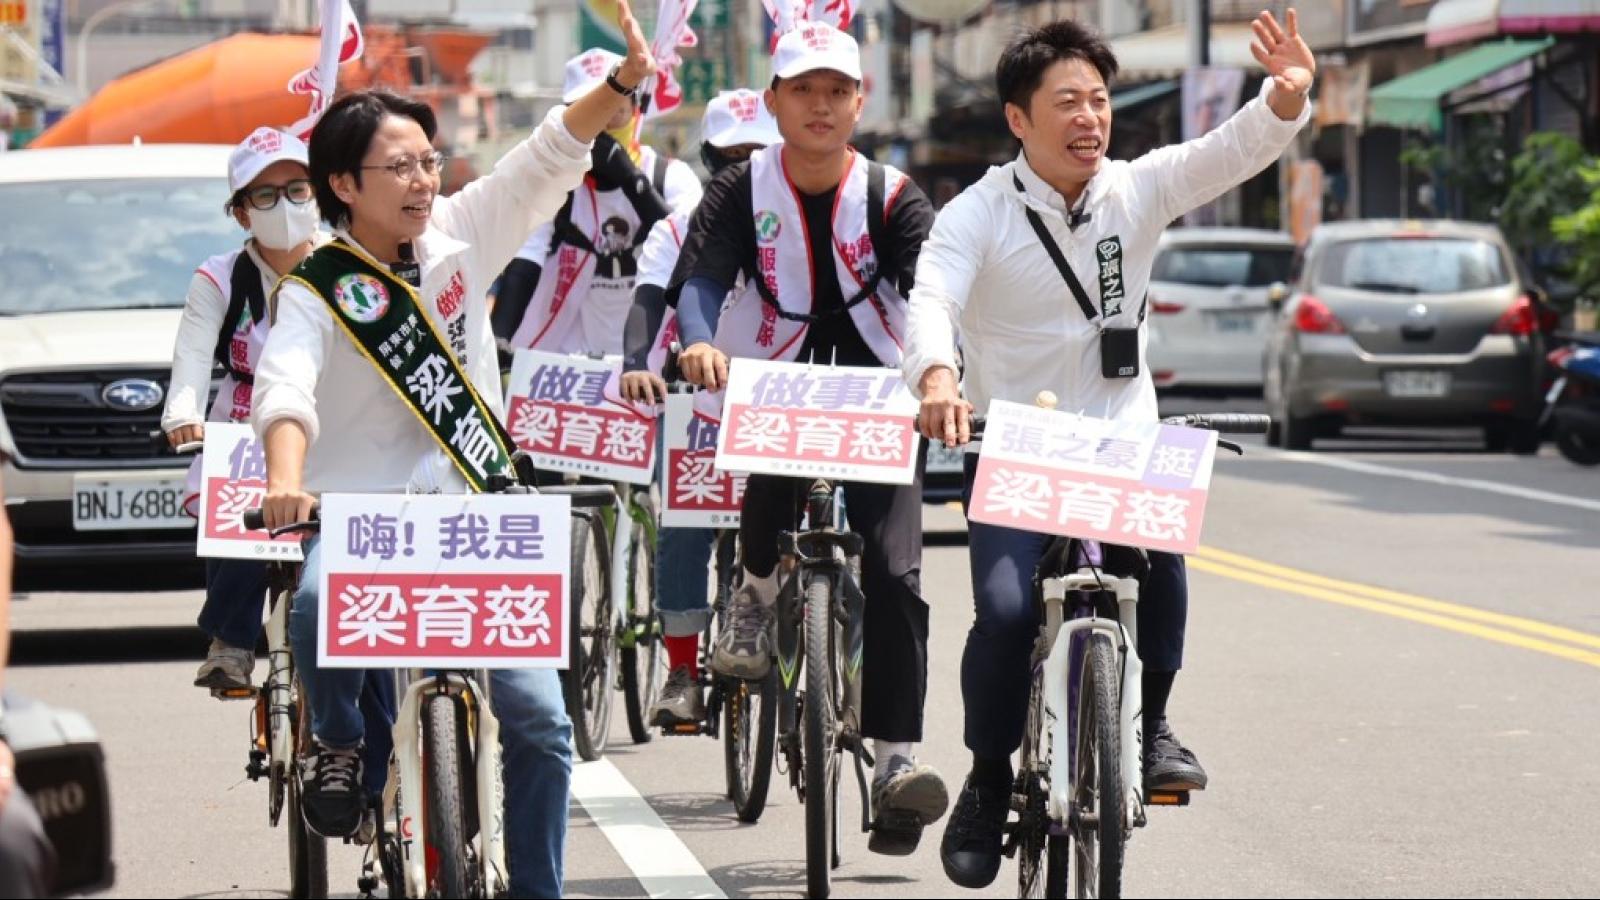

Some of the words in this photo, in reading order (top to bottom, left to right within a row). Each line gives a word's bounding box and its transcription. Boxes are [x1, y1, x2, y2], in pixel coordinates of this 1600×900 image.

[406, 353, 516, 480] 梁育
[751, 371, 902, 410] 做事!
[511, 402, 650, 463] 梁育慈
[733, 410, 906, 462] 梁育慈
[1001, 422, 1142, 471] 張之豪
[1152, 443, 1198, 479] 挺
[983, 467, 1191, 542] 梁育慈
[346, 512, 416, 561] 嗨!
[438, 512, 546, 561] 我是
[337, 583, 552, 648] 梁育慈
